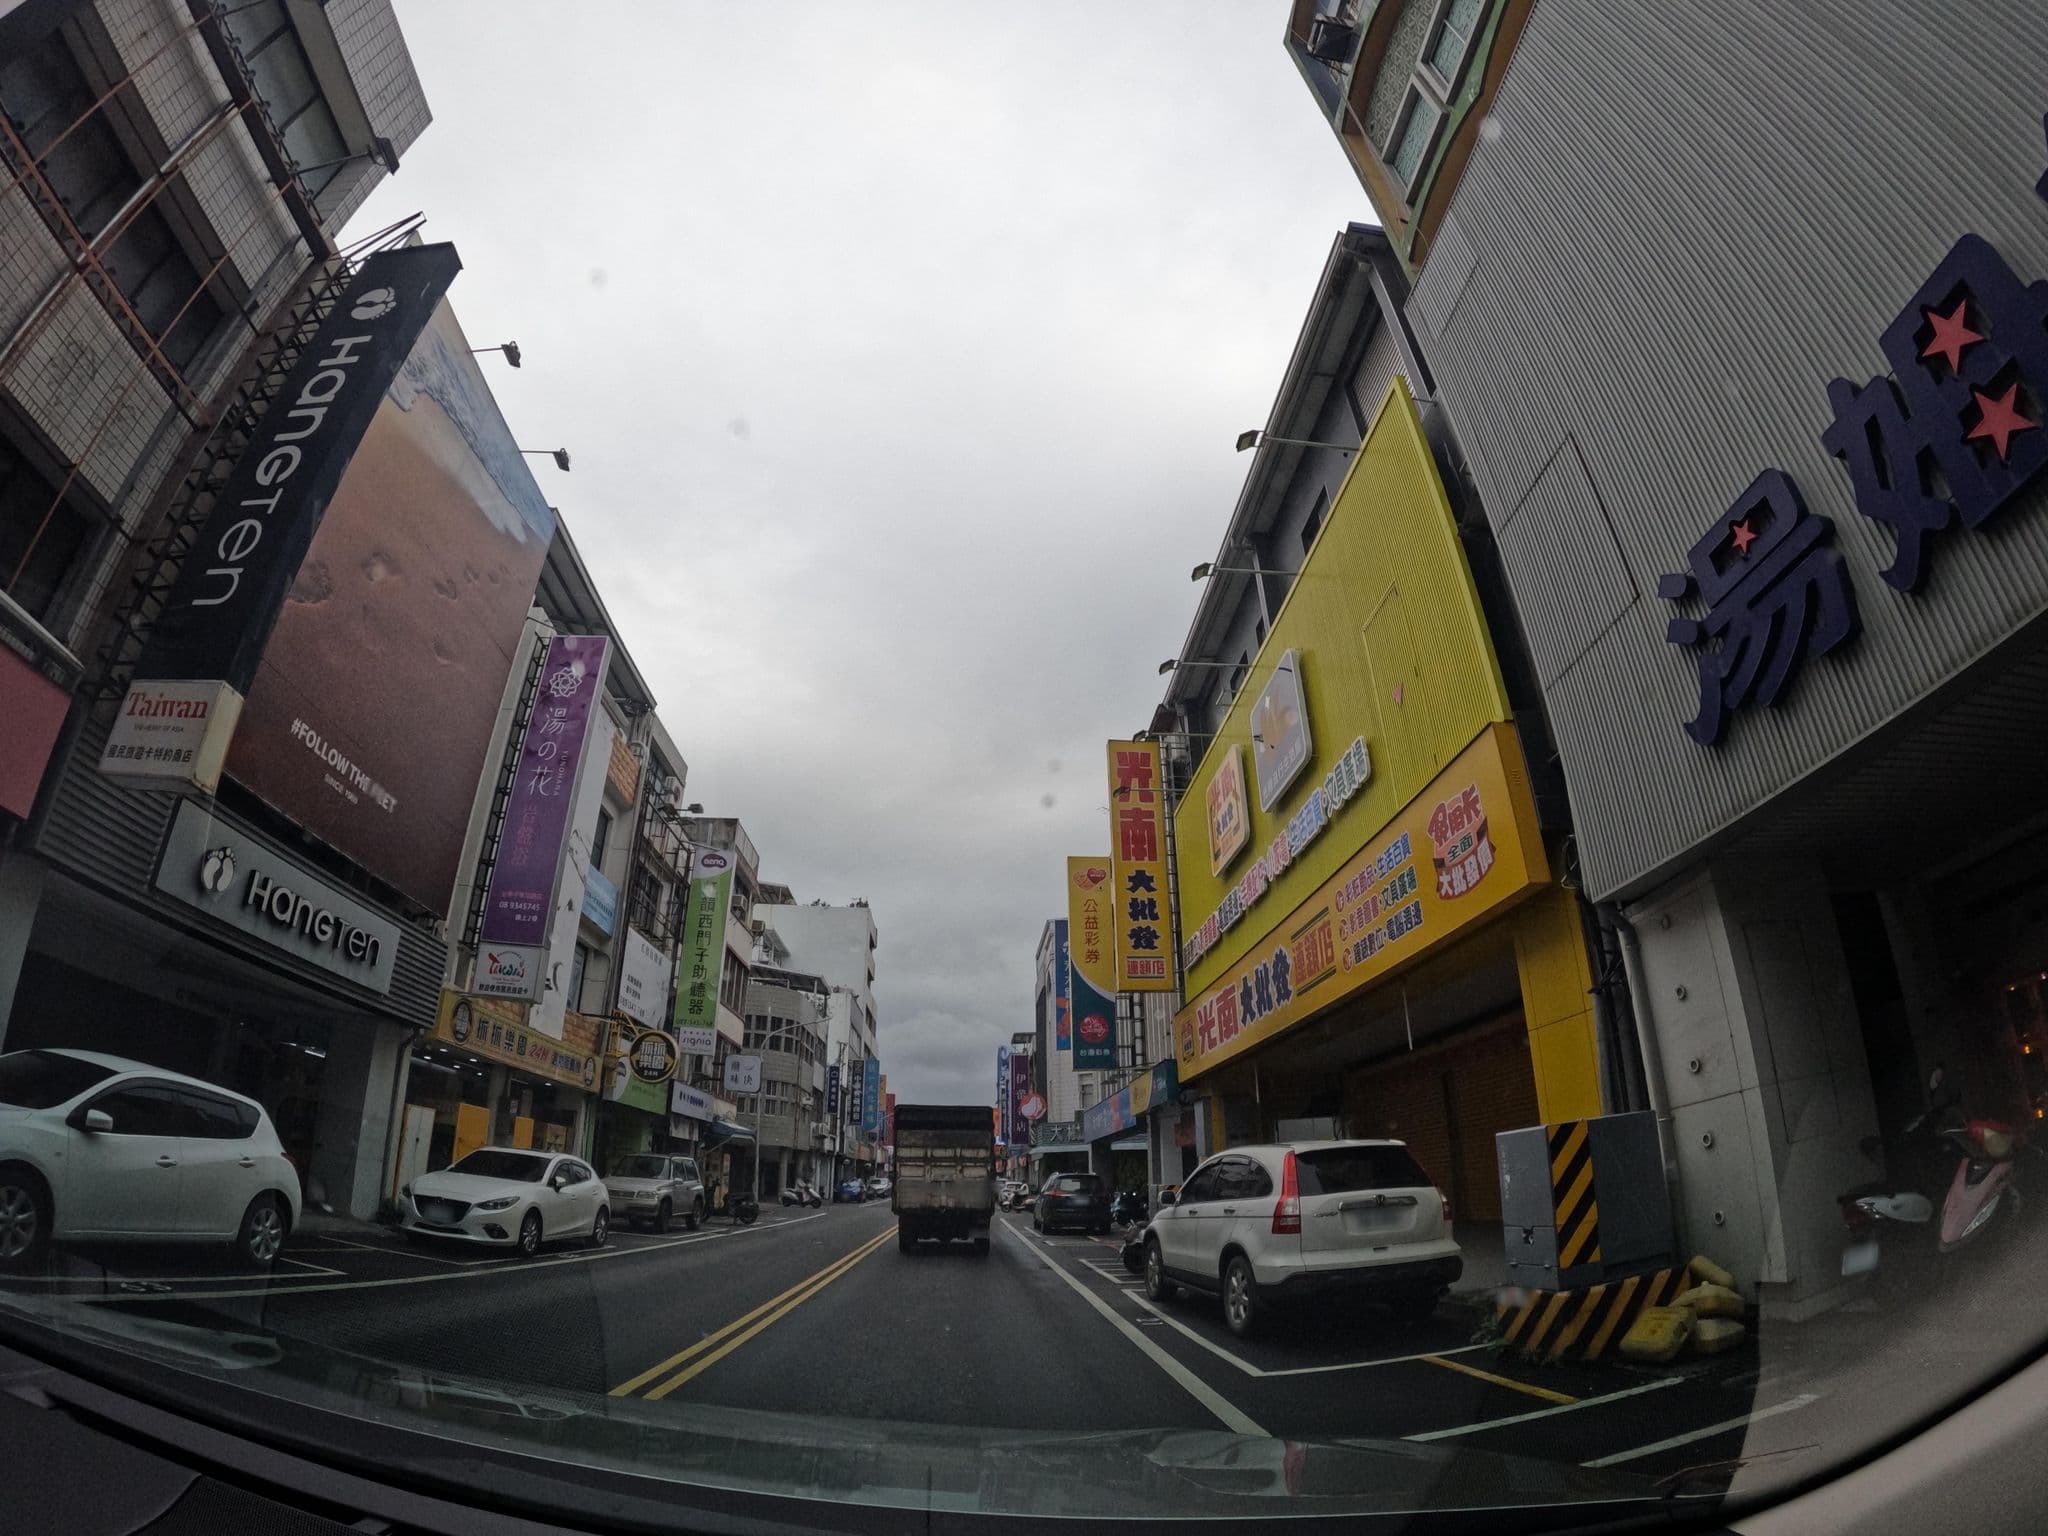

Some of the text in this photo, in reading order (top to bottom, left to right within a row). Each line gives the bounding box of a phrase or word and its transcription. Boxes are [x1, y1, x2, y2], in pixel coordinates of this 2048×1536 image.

[126, 692, 209, 719] Taiwan
[528, 707, 567, 797] 湯の花
[1376, 831, 1413, 881] 生活百貨
[1447, 831, 1473, 860] 全面
[1083, 898, 1100, 964] 公益彩券
[682, 1035, 712, 1048] signia
